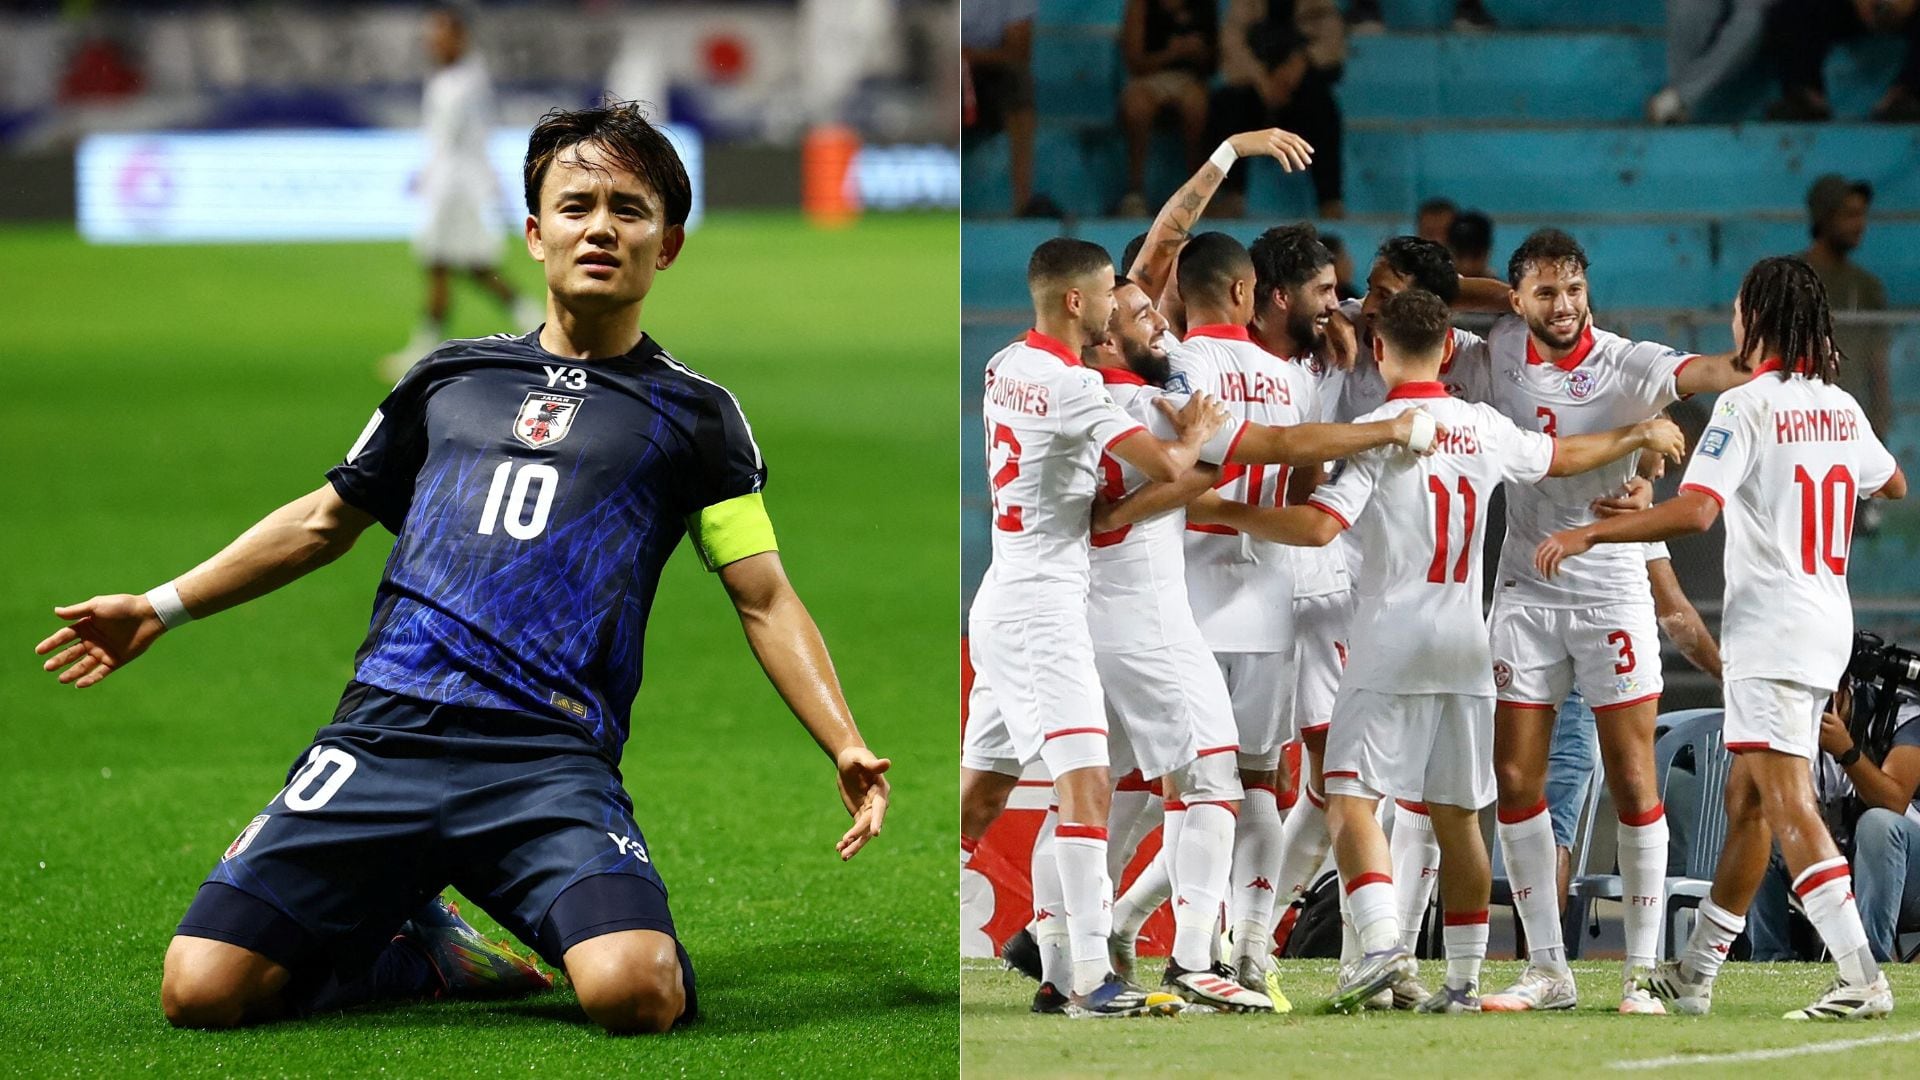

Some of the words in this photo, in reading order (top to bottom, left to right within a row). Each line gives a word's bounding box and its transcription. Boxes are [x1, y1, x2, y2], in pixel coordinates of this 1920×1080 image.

[543, 366, 588, 390] Y-3
[526, 427, 550, 438] JFA
[477, 461, 559, 540] 10
[1795, 464, 1855, 575] 10
[1427, 475, 1477, 584] 11
[1607, 629, 1637, 674] 3
[607, 832, 649, 863] Y-3
[1632, 896, 1657, 907] FTF
